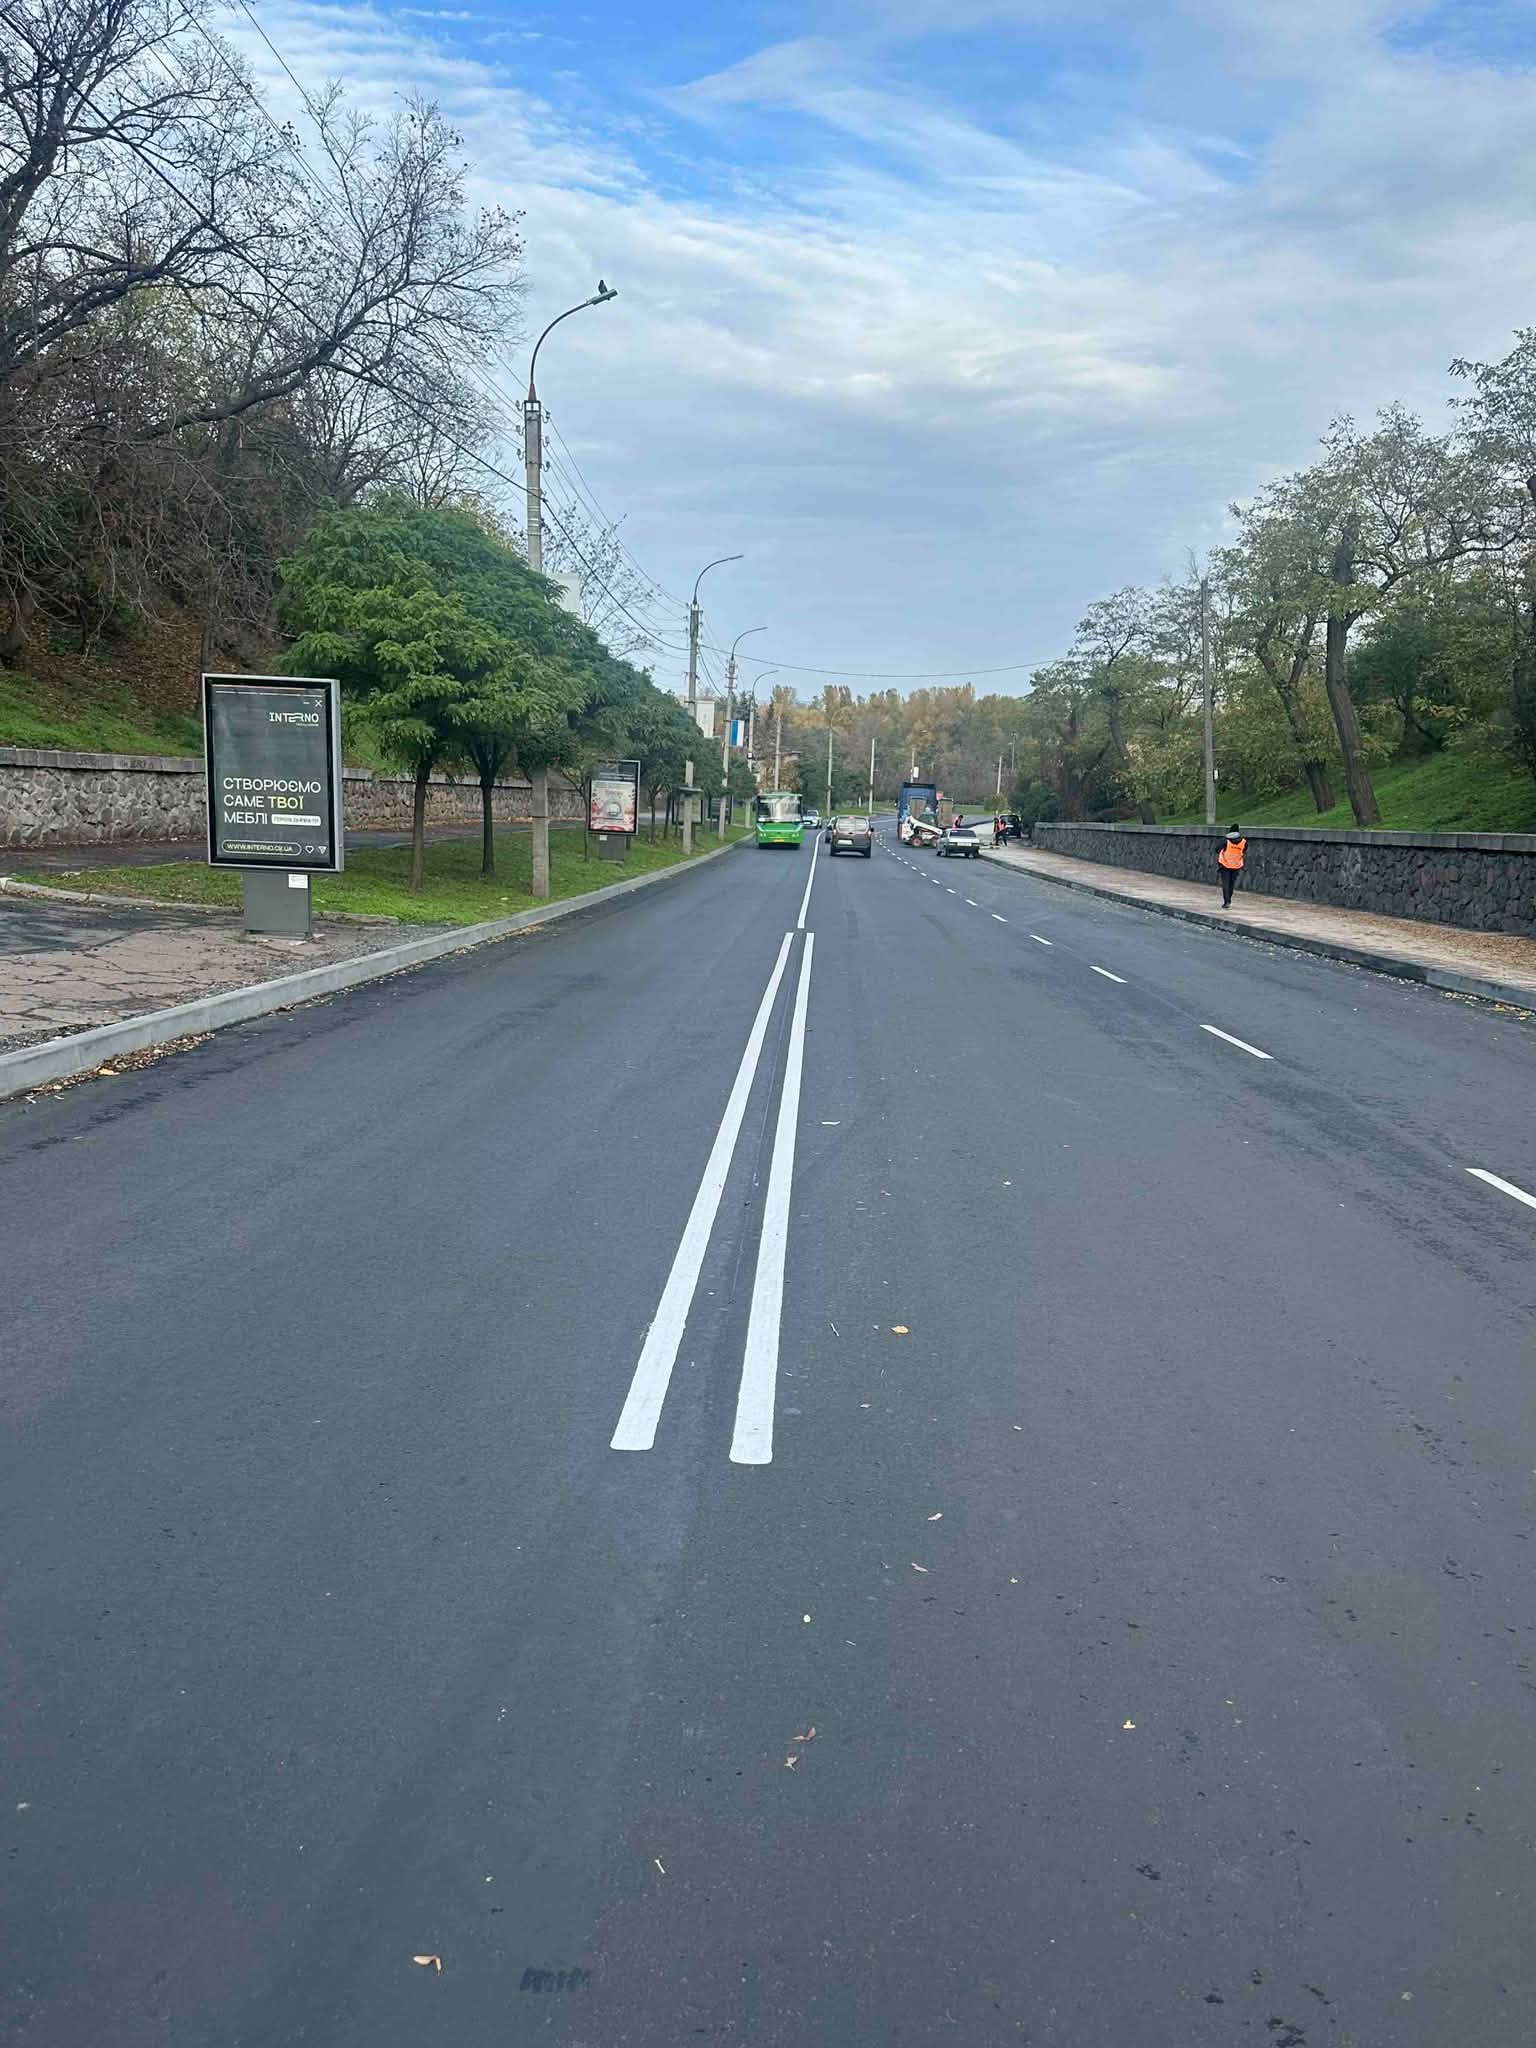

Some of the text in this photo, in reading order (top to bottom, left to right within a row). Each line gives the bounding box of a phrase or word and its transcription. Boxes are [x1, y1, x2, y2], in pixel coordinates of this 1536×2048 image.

[269, 712, 319, 723] INTERNO
[223, 777, 321, 793] СТВОРЮЄМО
[223, 794, 304, 810] САМЕ ТВОЇ
[224, 811, 268, 825] МЕБЛІ
